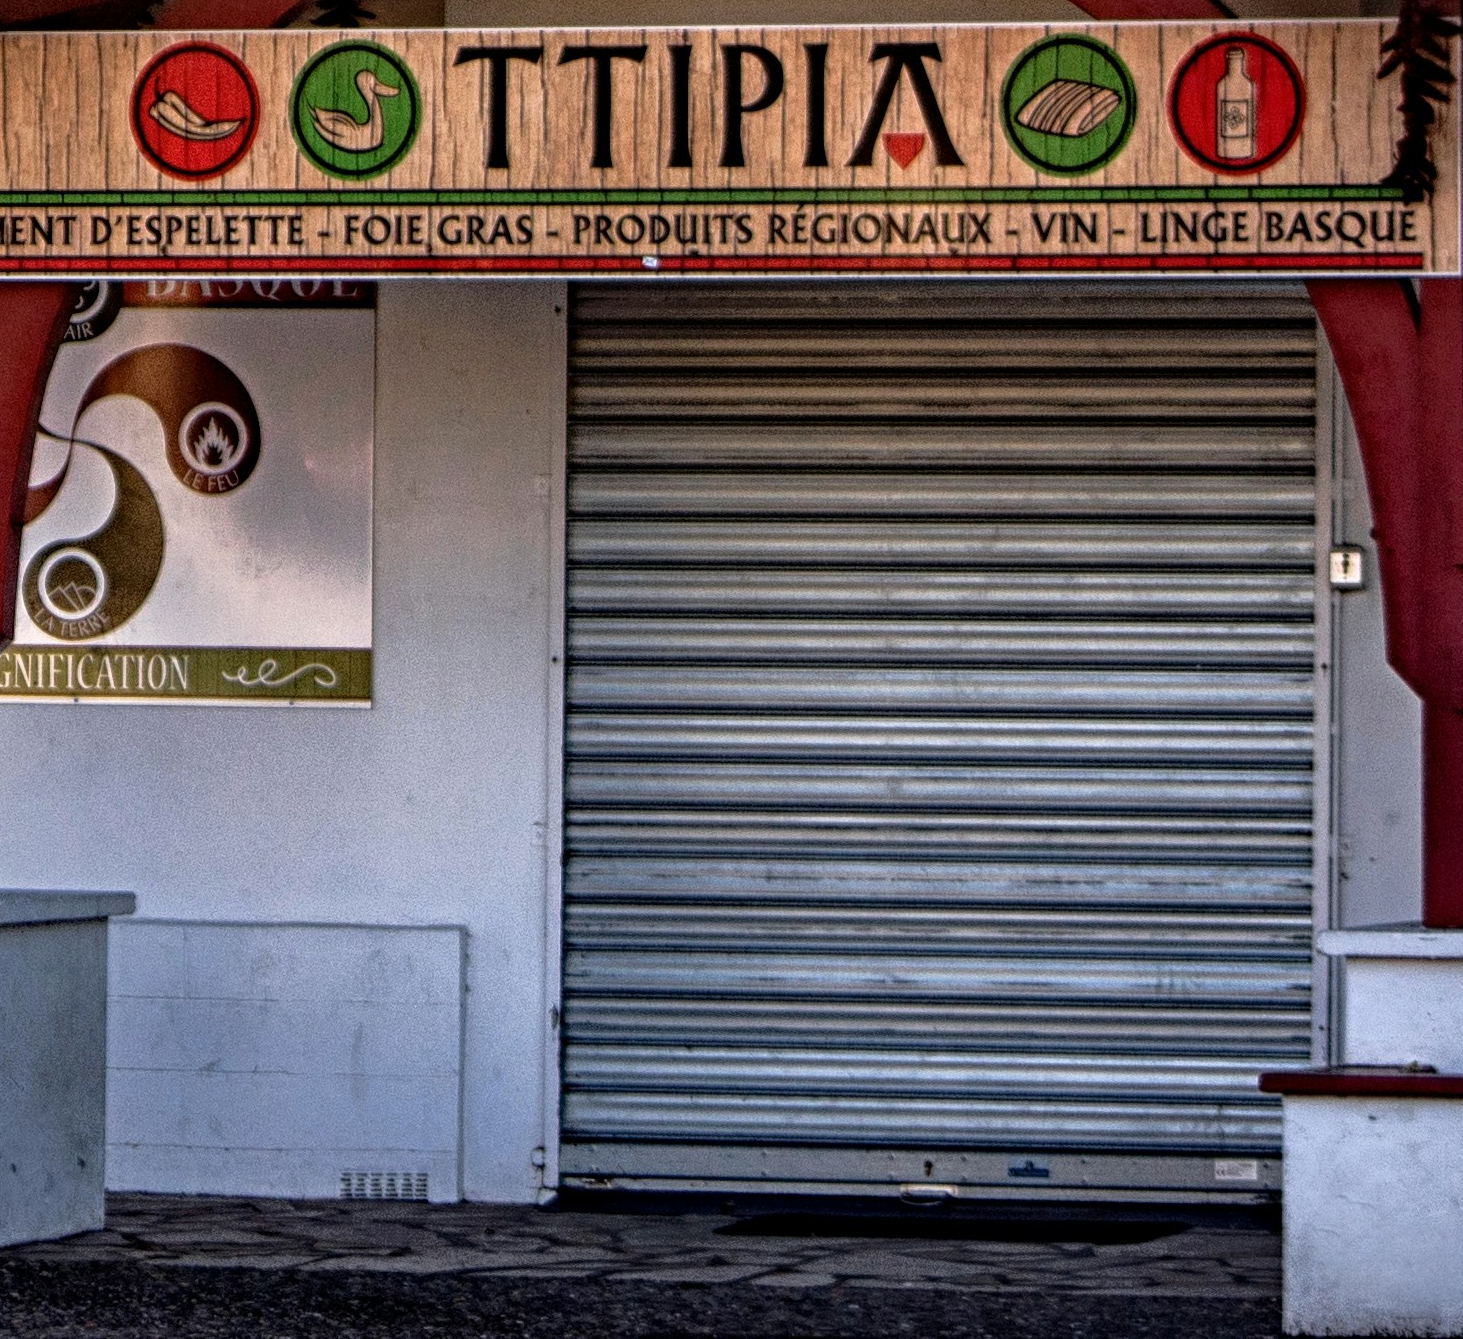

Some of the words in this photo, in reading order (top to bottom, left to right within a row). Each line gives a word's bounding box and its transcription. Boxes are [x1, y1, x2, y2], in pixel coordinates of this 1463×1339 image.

[453, 42, 965, 169] TTIPIA
[89, 214, 305, 245] D'ESPELETTE
[342, 214, 424, 245] FOIE
[436, 214, 533, 245] GRAS
[574, 213, 754, 245] PRODUITS
[767, 202, 993, 245] RÉGIONAUX
[1031, 211, 1098, 244] VIN
[1140, 210, 1250, 244] LINGE
[1264, 210, 1418, 248] BASQUE
[183, 473, 202, 491] LE
[207, 472, 241, 493] FEU
[33, 606, 55, 631] LA
[59, 609, 111, 638] TERRE
